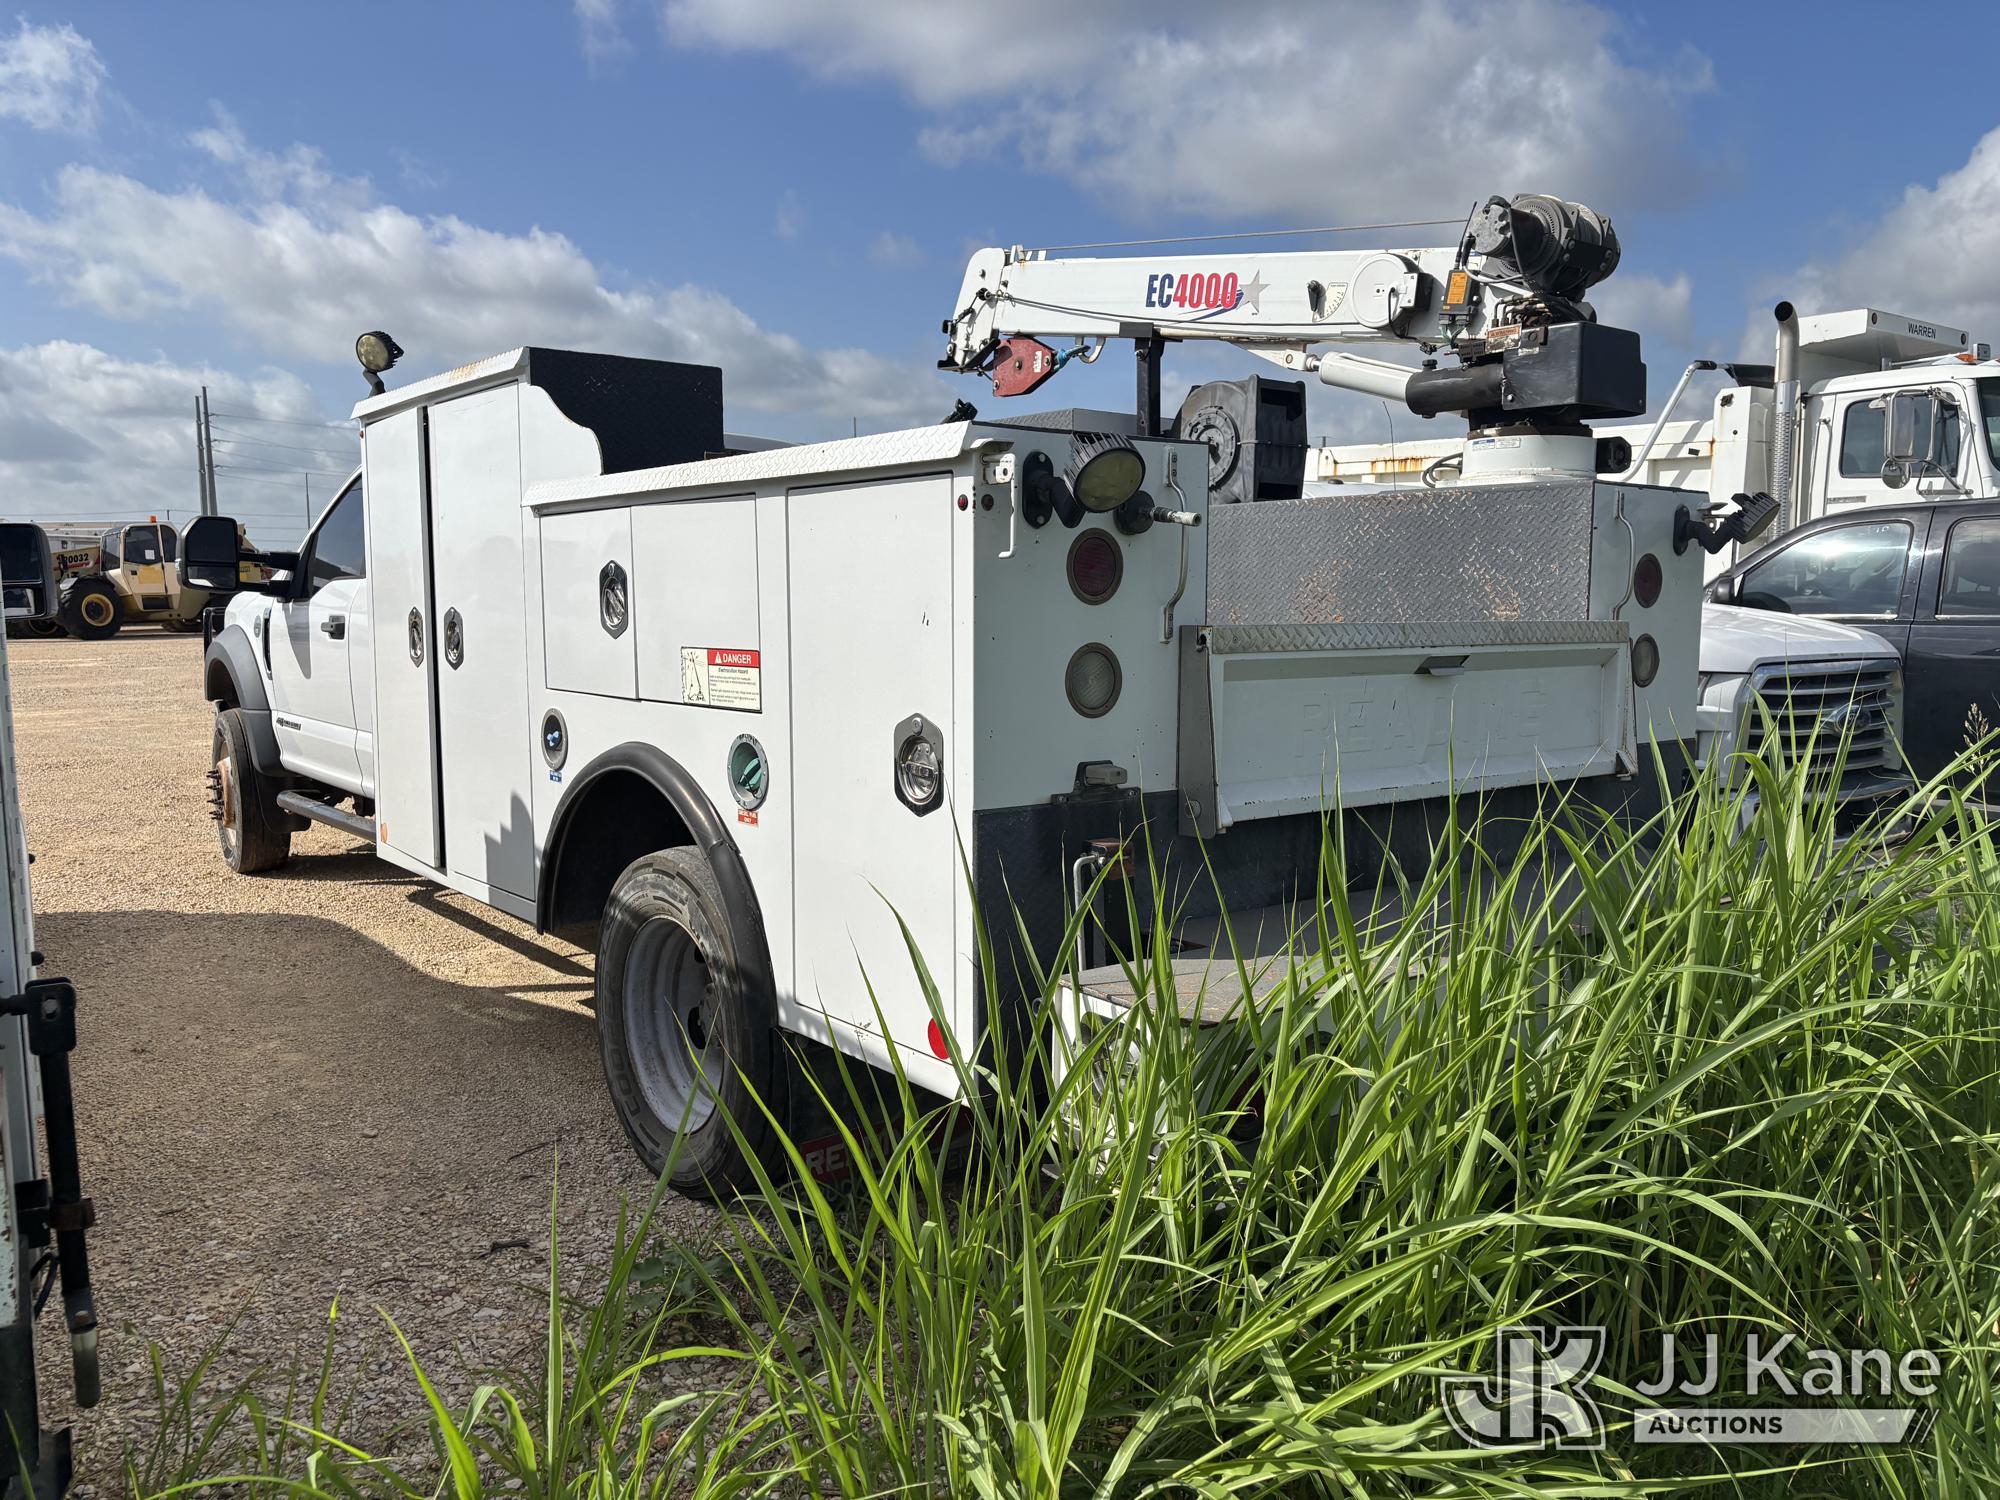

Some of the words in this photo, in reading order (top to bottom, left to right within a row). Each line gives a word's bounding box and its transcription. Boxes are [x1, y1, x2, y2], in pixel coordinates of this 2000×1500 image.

[1145, 271, 1239, 310] EC4000
[1907, 322, 1936, 339] WARREN
[722, 653, 751, 664] DANGER
